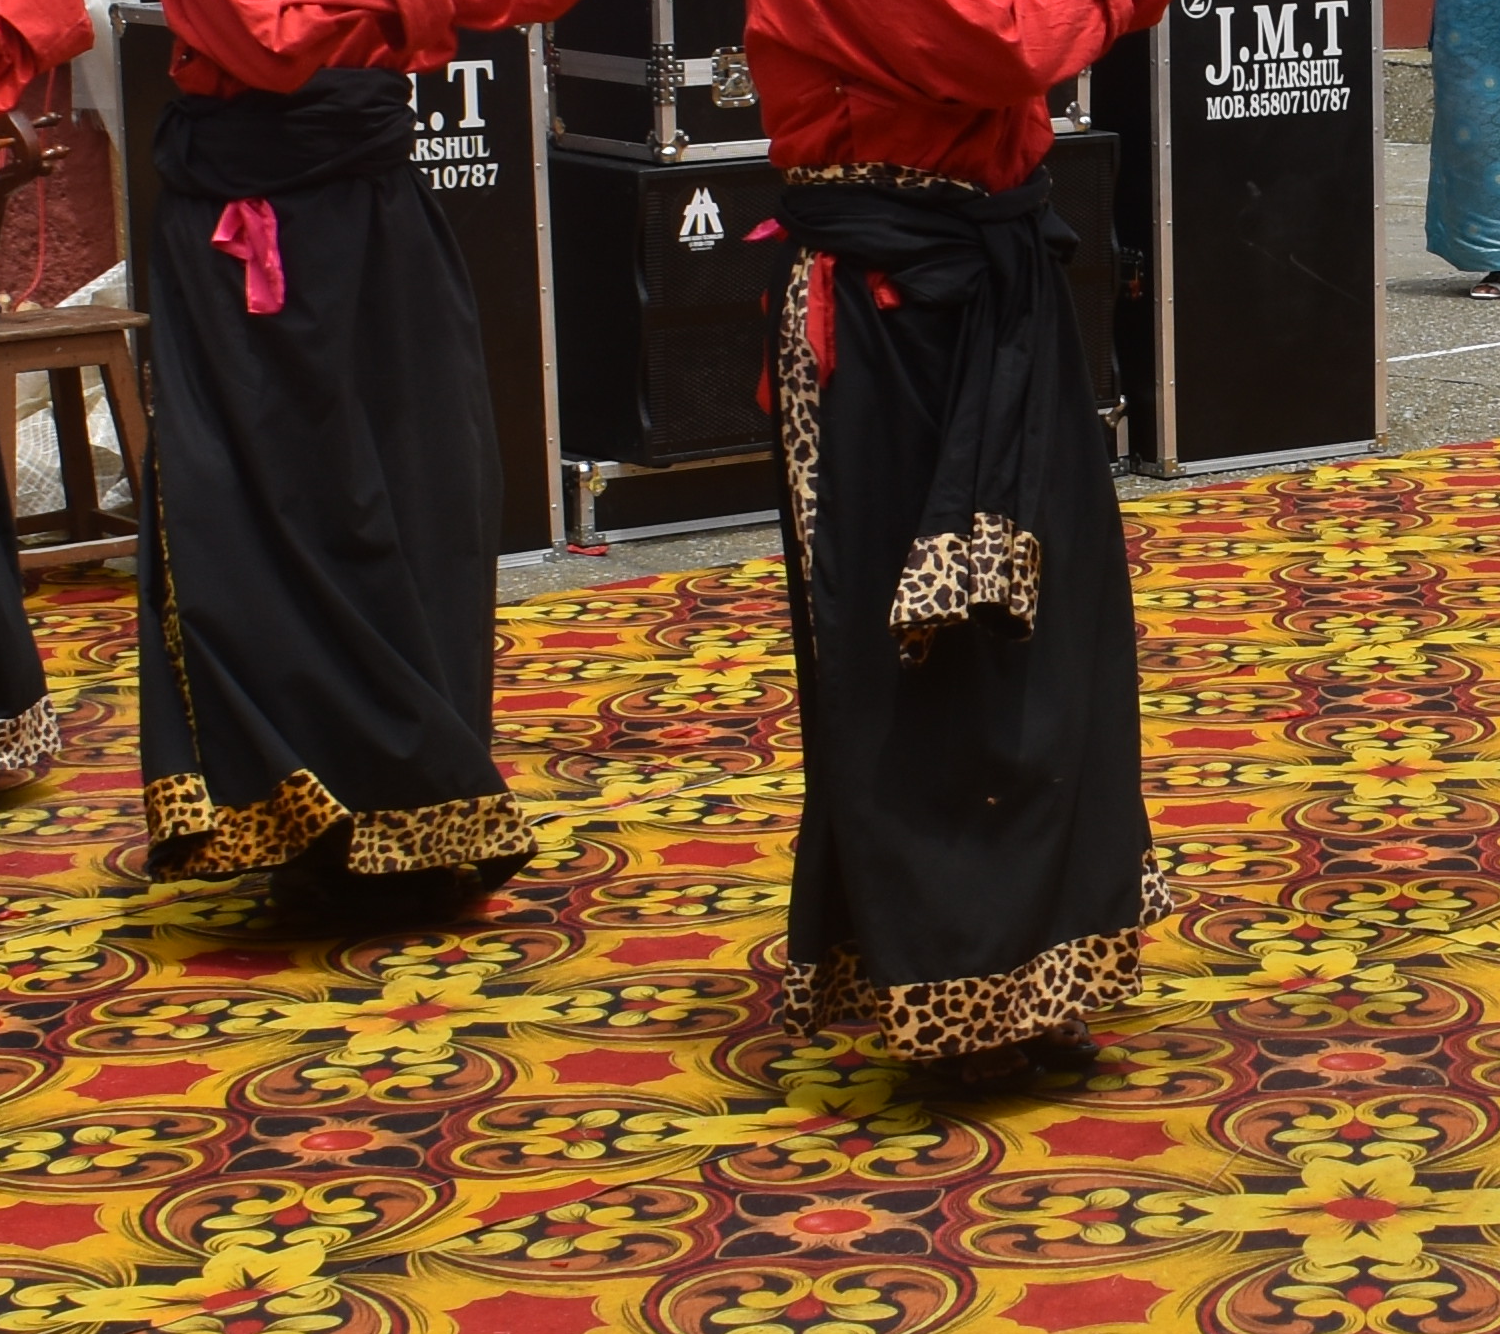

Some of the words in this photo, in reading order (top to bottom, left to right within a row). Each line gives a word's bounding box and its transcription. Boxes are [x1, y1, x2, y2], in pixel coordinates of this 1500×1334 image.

[1205, 0, 1349, 86] J.M.T
[1232, 64, 1260, 92] D.J
[1264, 58, 1344, 90] HARSHUL
[1206, 87, 1351, 121] MOB.8580710787
[410, 135, 490, 162] RSHUL
[420, 163, 499, 190] 10787
